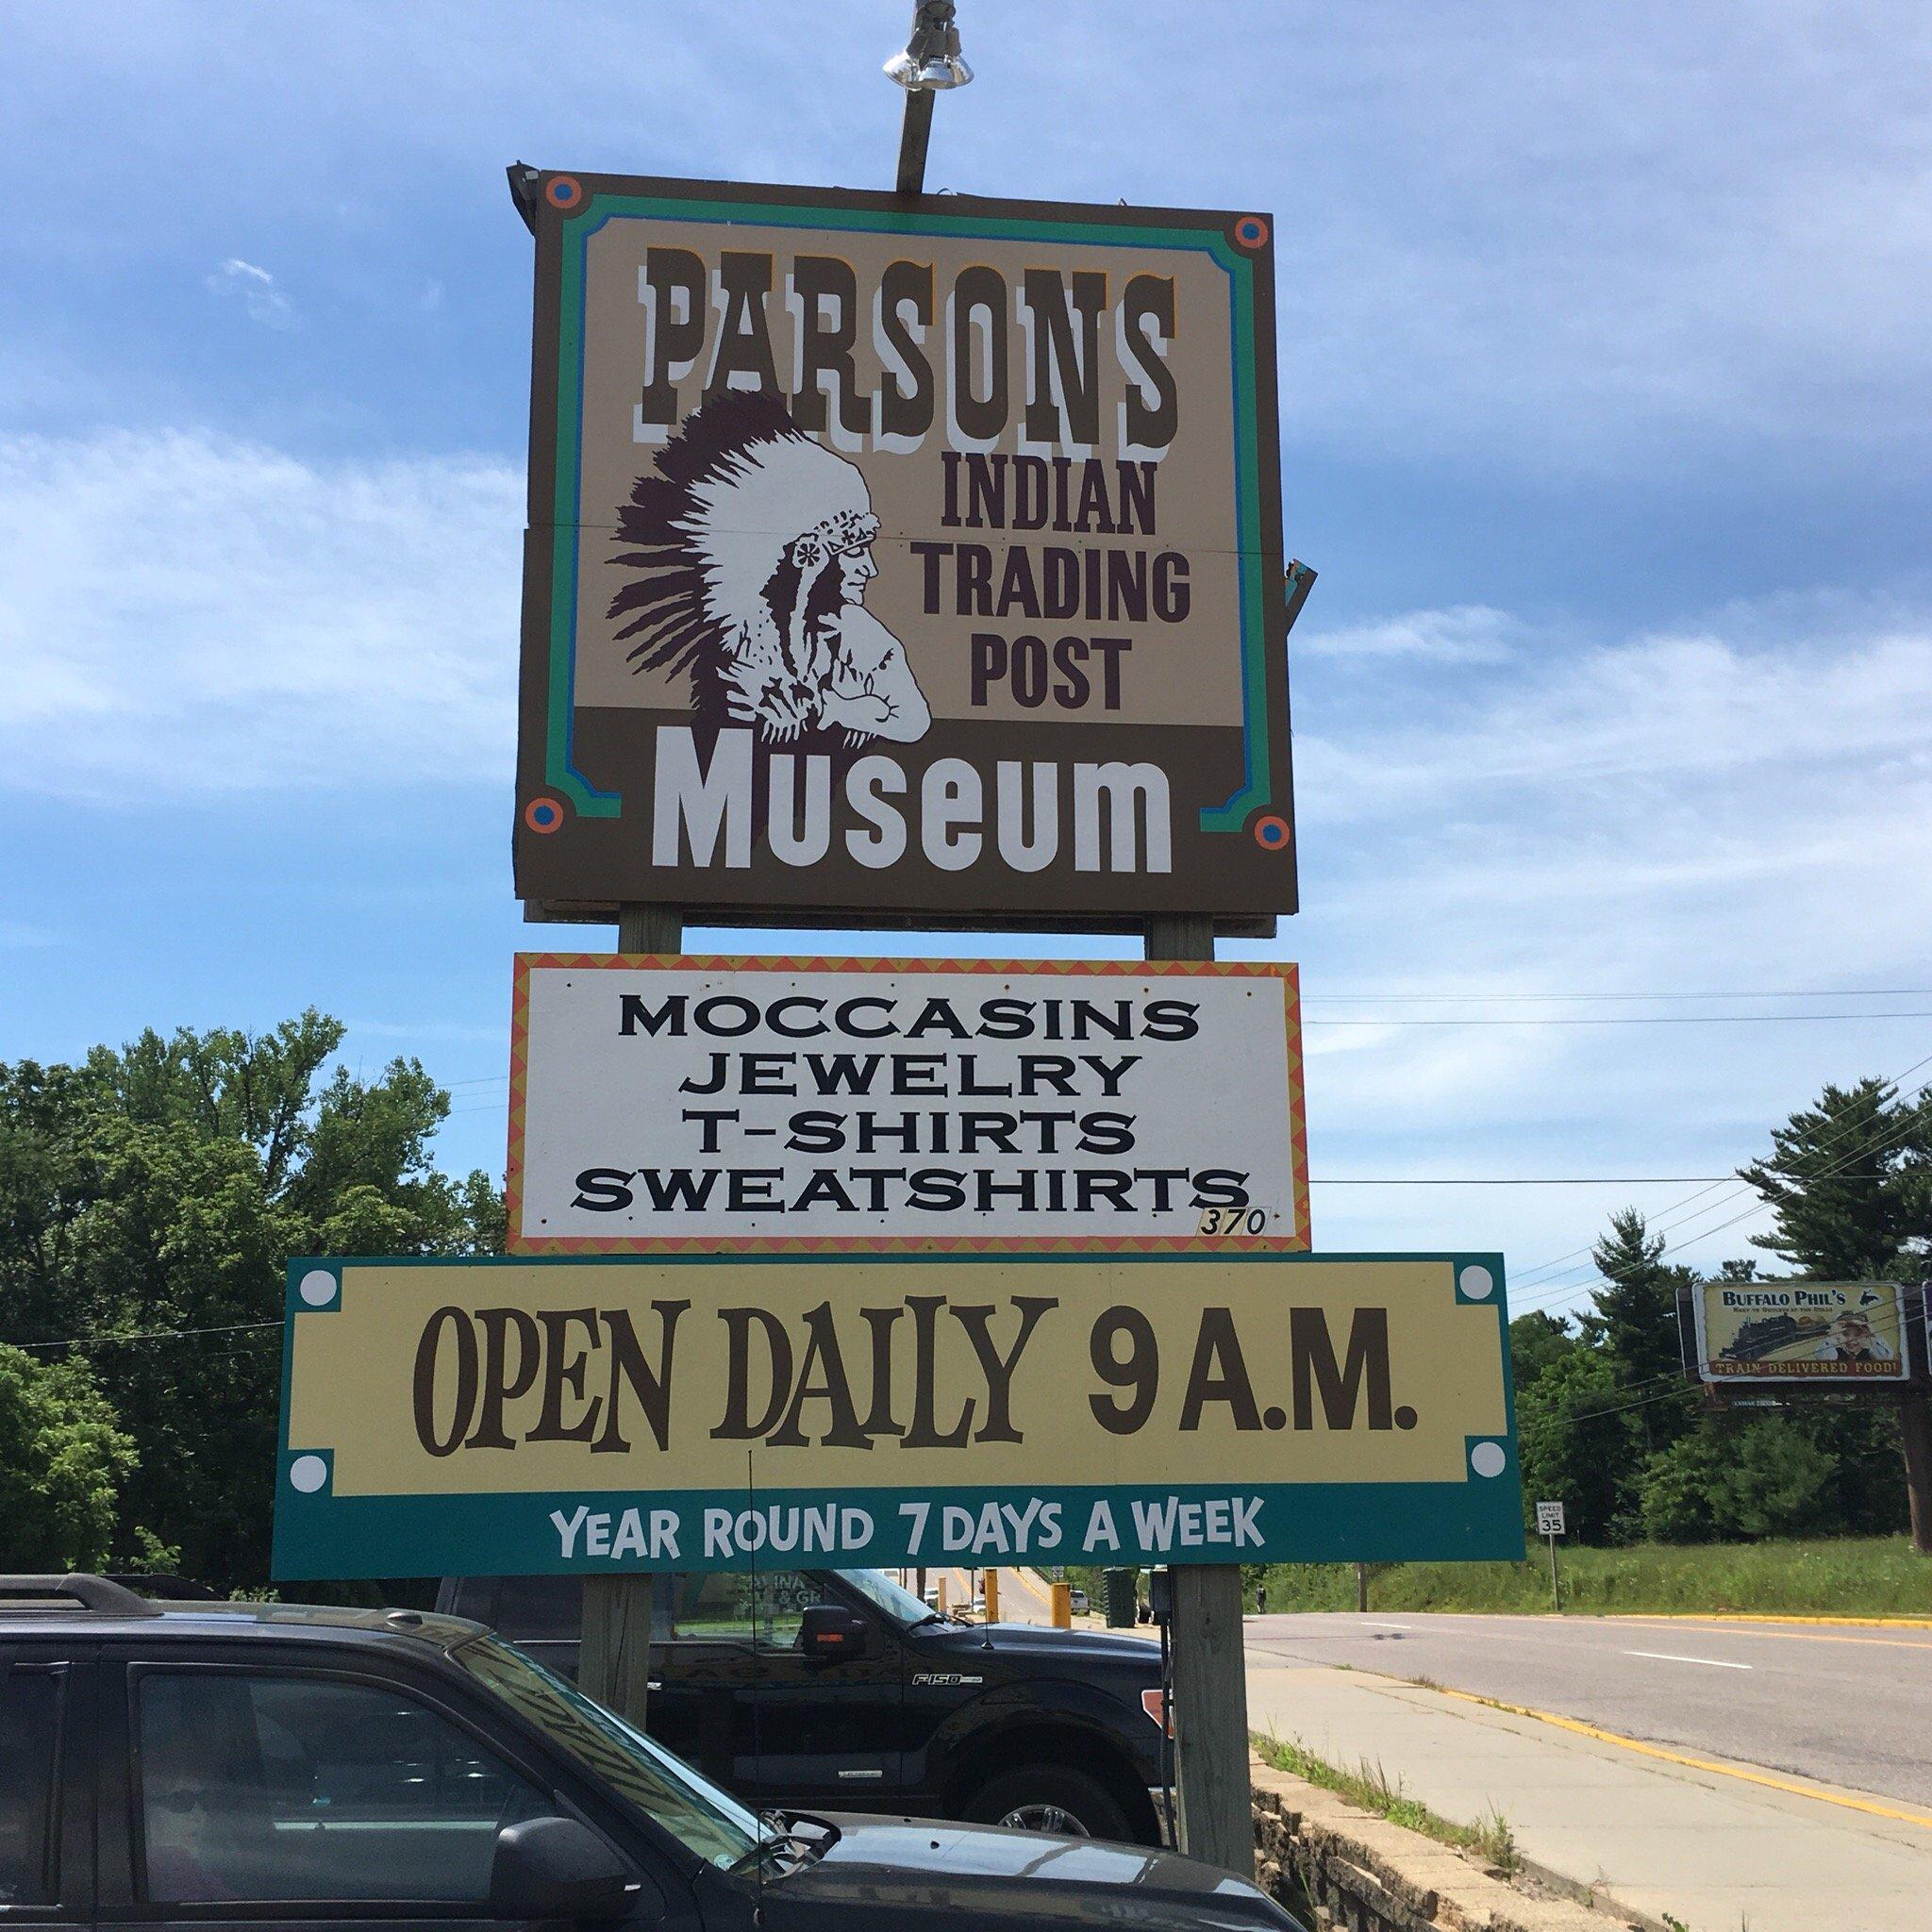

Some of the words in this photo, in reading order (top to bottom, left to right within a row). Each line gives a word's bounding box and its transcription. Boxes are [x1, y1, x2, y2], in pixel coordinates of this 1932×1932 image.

[635, 245, 1179, 459] PARSONS
[940, 451, 1158, 536] INDIAN
[909, 542, 1191, 624] TRADING
[970, 635, 1134, 711] POST
[651, 724, 1174, 875] Museum
[619, 994, 1201, 1041] MOCCASINS
[678, 1051, 1143, 1099] JEWELRY
[681, 1108, 1139, 1156] T-SHIRTS
[570, 1166, 1251, 1214] SWEATSHIRTS
[1200, 1208, 1266, 1235] 370
[1723, 1291, 1790, 1307] BUFFALO
[1794, 1289, 1846, 1307] PHIL'S
[412, 1298, 692, 1457] OPEN
[709, 1294, 1059, 1451] DAILY
[1088, 1305, 1159, 1435] 9
[1178, 1307, 1419, 1432] A.M.
[1715, 1362, 1761, 1374] TRAIN
[1768, 1361, 1848, 1374] DELIVERED
[1855, 1361, 1897, 1374] FOOD!
[550, 1505, 682, 1561] YEAR
[704, 1503, 875, 1559] ROUND
[899, 1502, 932, 1556] 7
[942, 1497, 1063, 1555] DAYS
[1082, 1500, 1123, 1553] A
[1130, 1495, 1266, 1554] WEEK
[1541, 1519, 1562, 1531] 35
